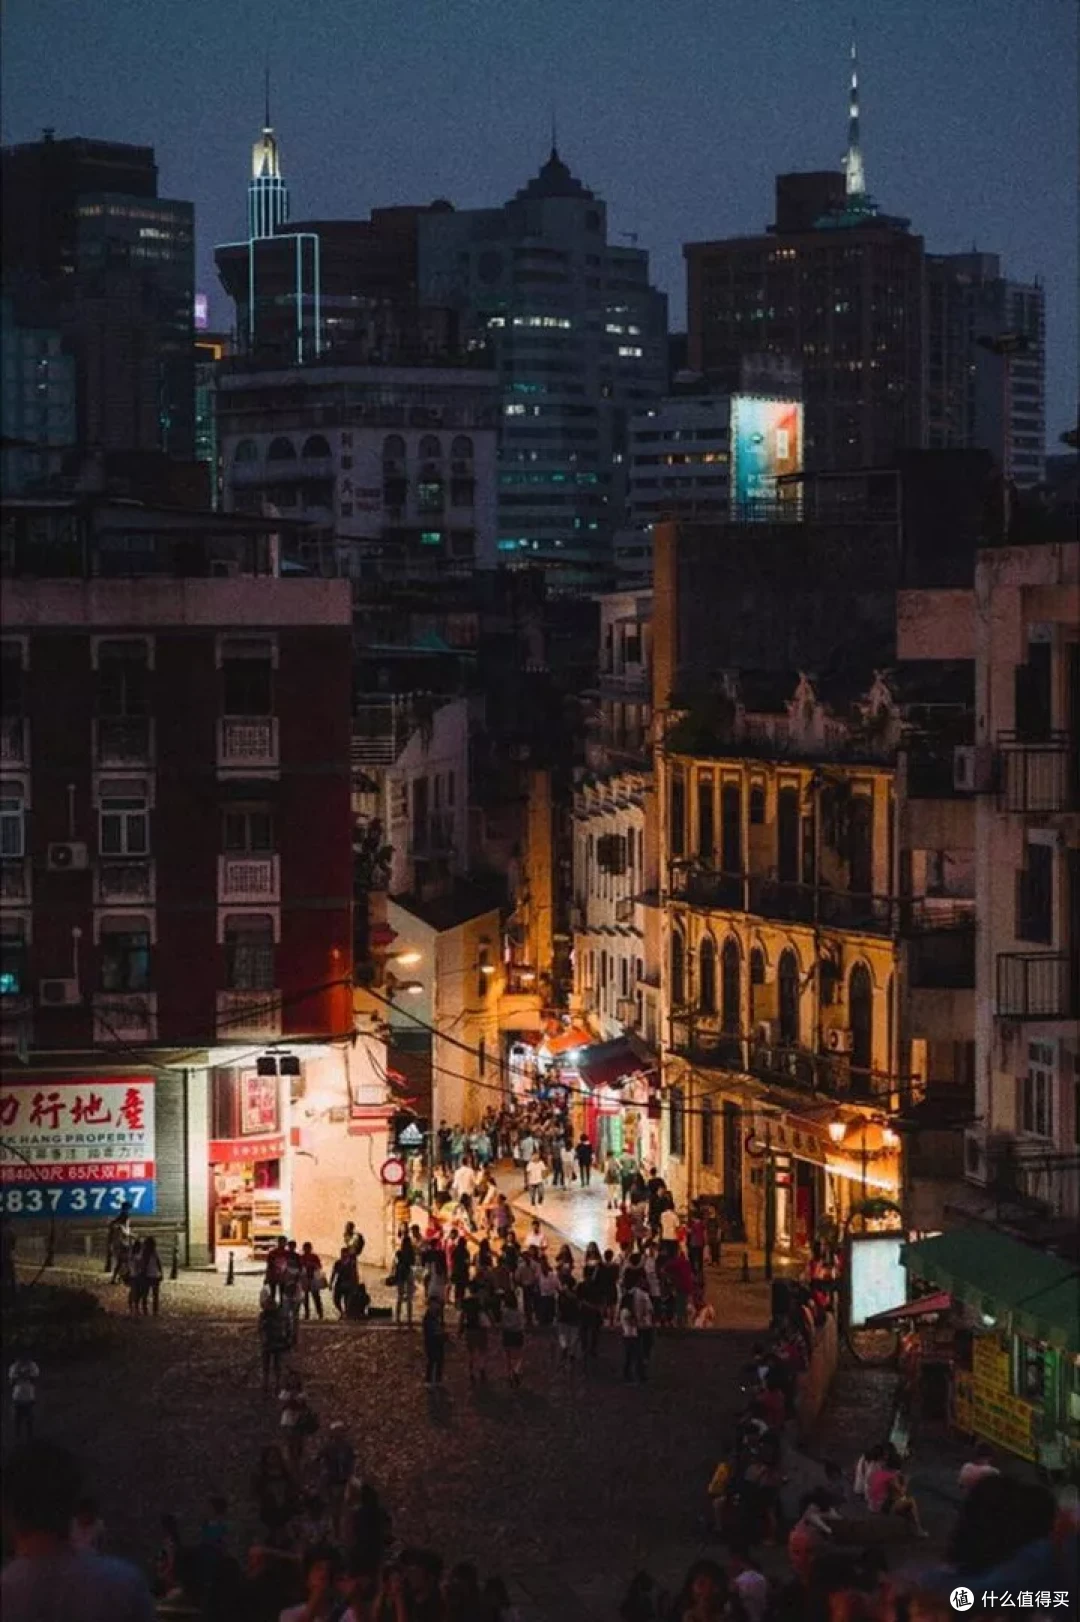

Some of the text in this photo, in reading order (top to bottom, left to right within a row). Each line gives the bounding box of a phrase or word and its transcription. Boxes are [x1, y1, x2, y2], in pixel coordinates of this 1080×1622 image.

[20, 1134, 61, 1144] HANG
[65, 1133, 145, 1144] PROPERTY
[70, 1187, 147, 1211] 3737
